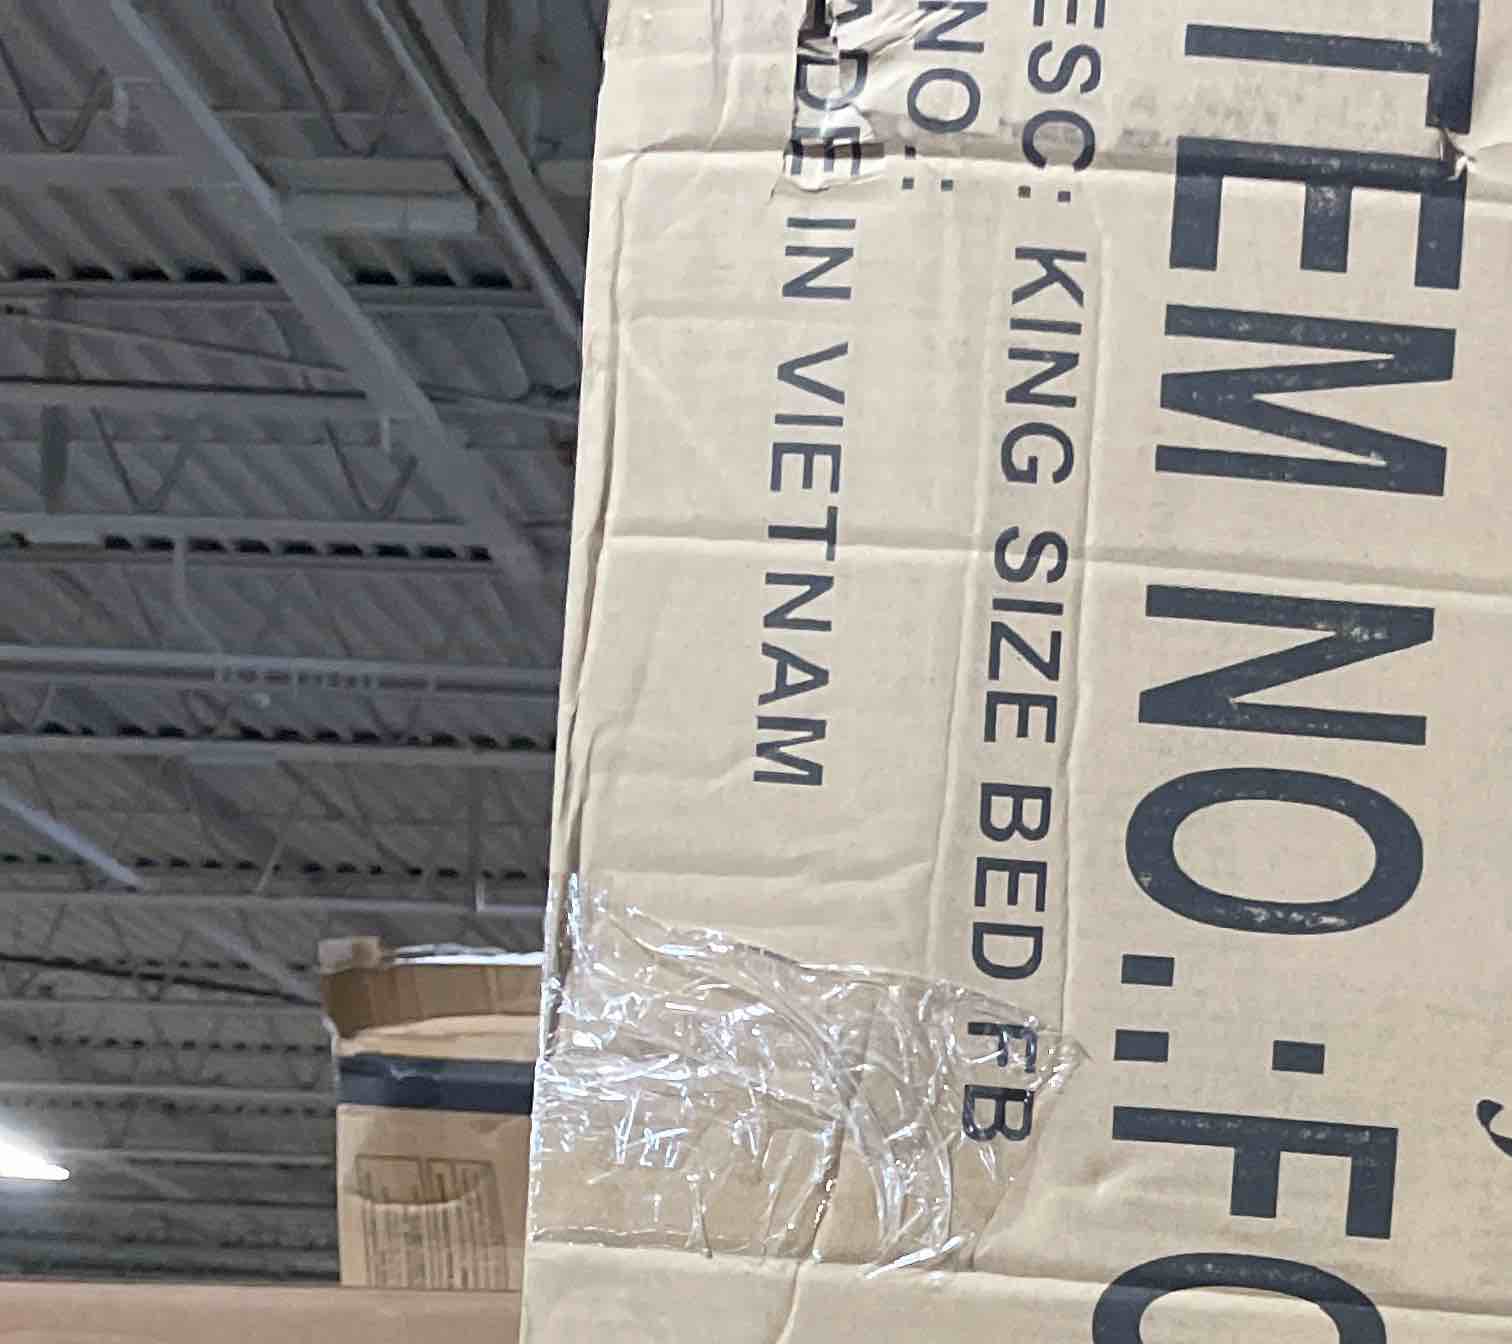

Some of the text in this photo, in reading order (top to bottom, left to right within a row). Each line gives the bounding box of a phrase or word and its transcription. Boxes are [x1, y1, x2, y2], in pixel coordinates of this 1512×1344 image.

[781, 216, 858, 301] IN
[999, 246, 1088, 486] KING
[752, 341, 849, 787] VIETNAM
[983, 525, 1069, 744] SIZE
[970, 783, 1052, 981] BED
[961, 1021, 1039, 1144] FB
